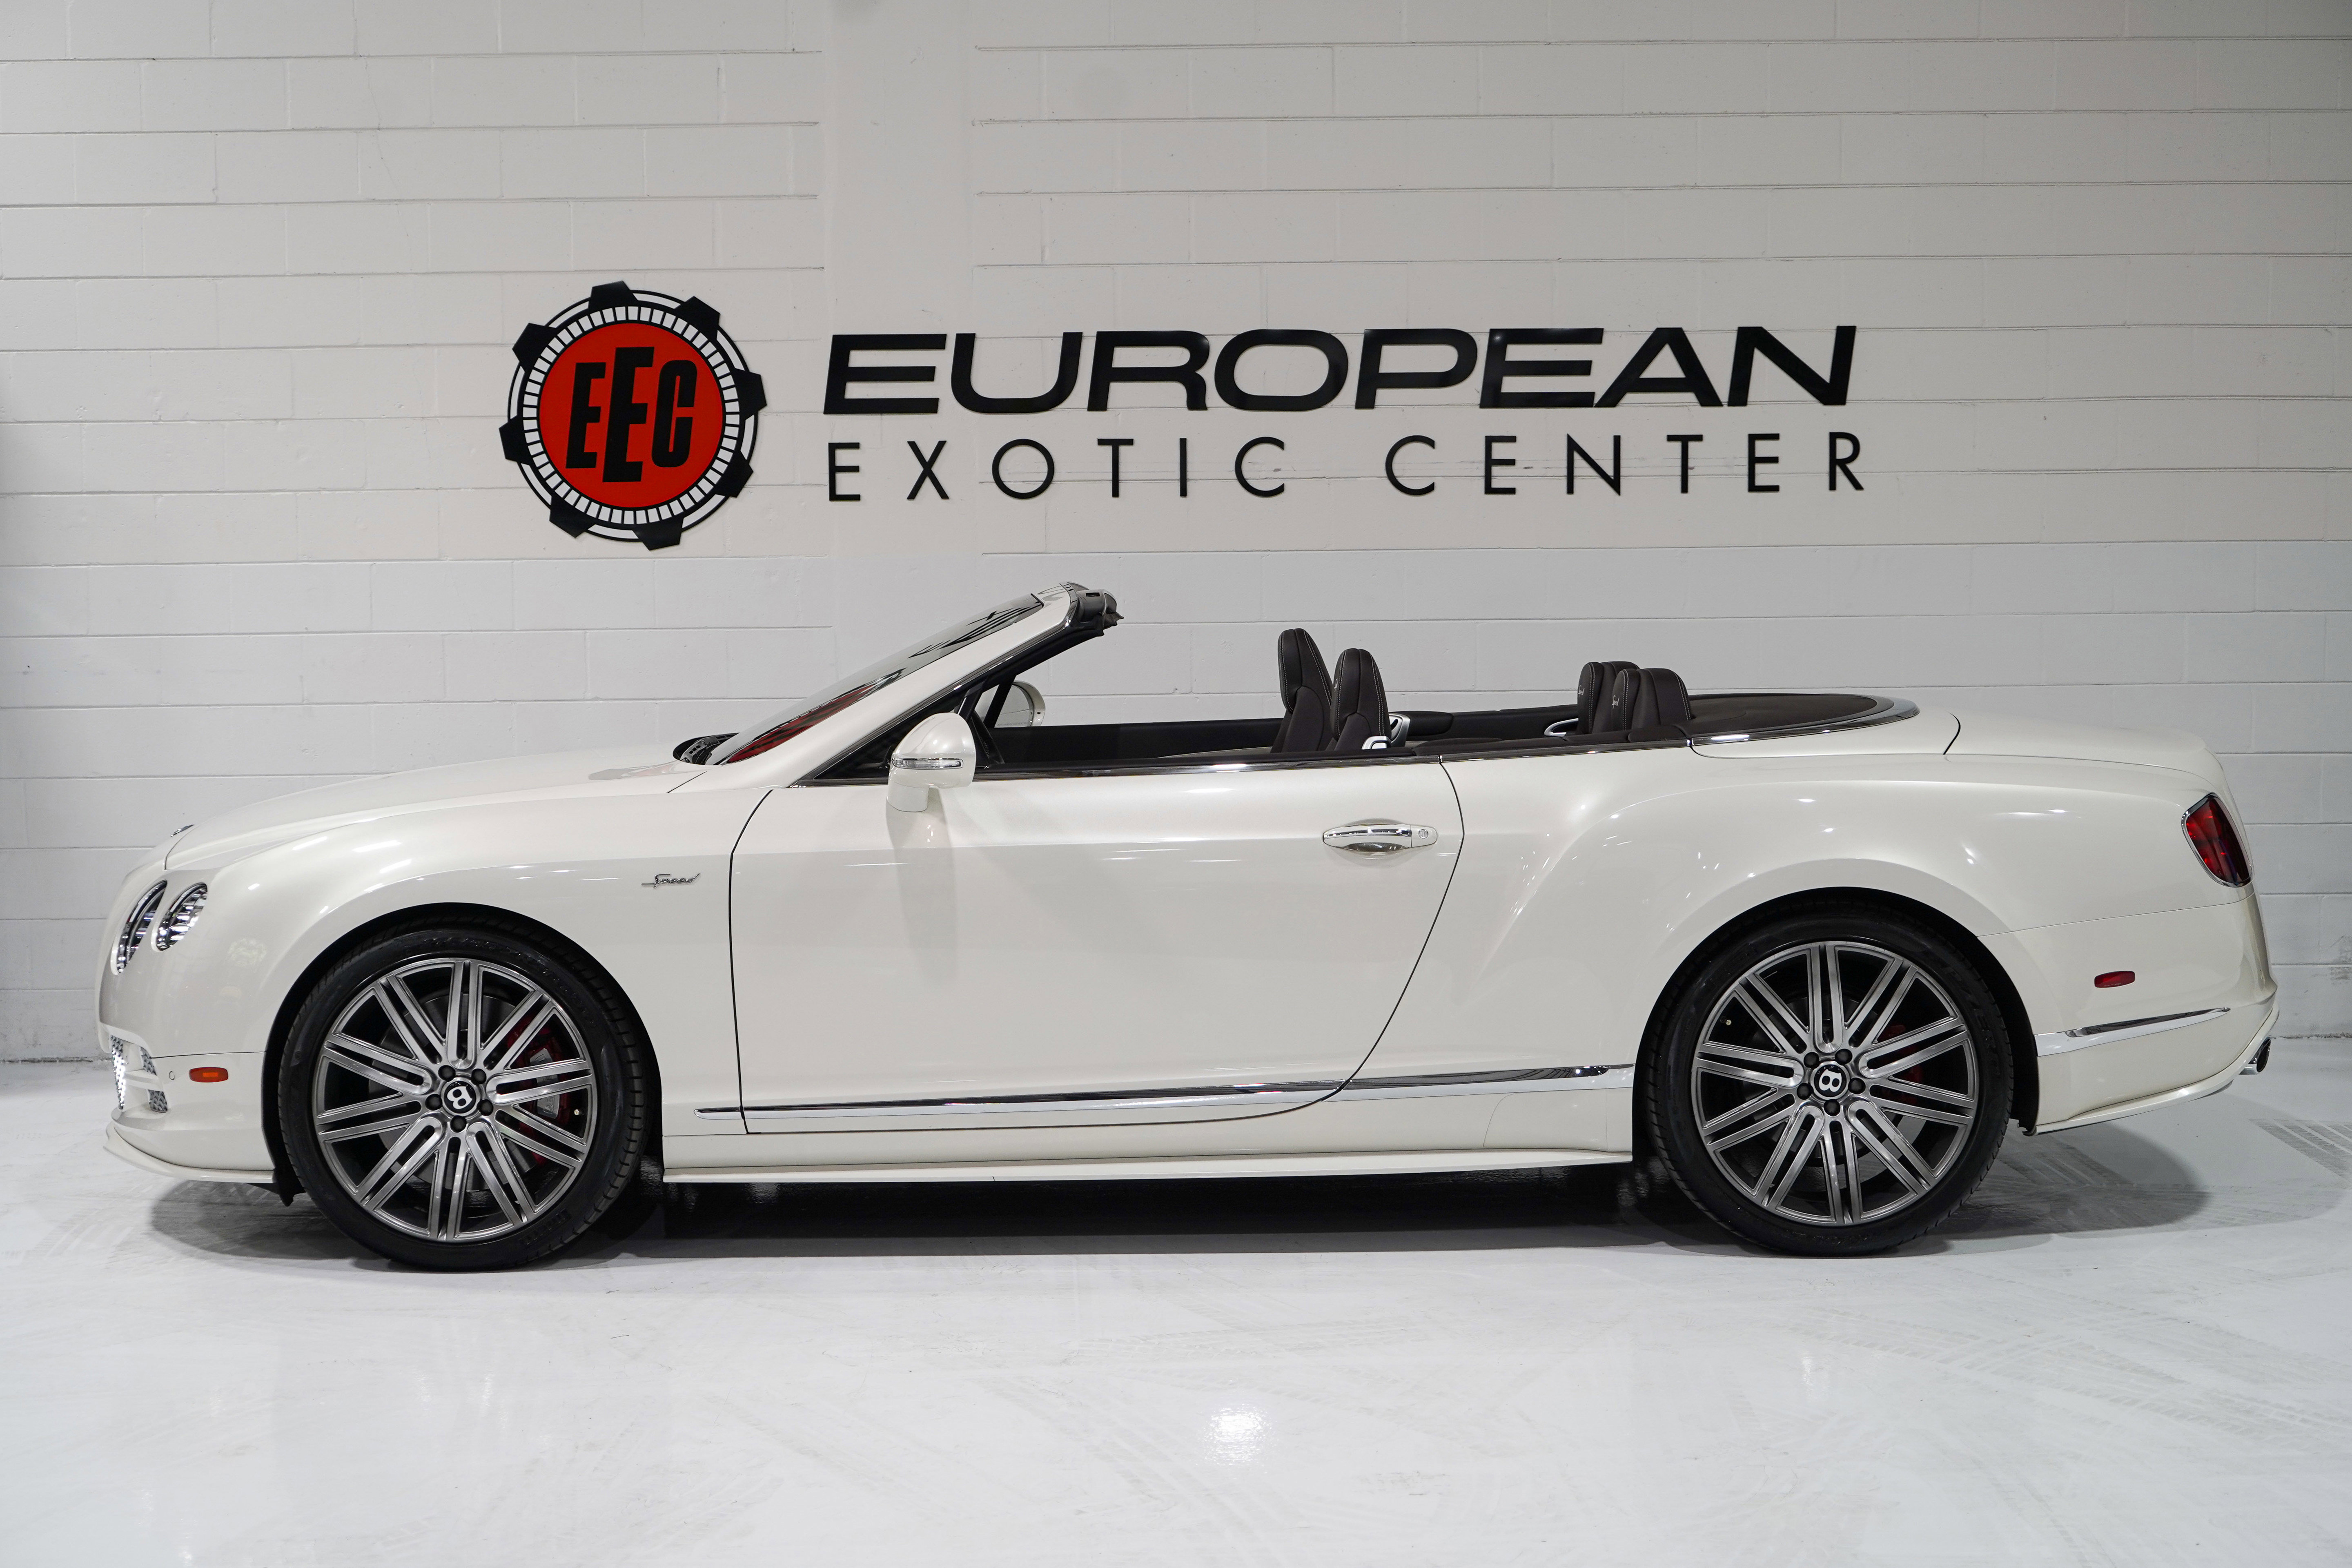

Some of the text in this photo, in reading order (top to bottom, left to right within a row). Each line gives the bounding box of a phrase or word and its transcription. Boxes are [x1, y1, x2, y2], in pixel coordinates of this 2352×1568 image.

[823, 325, 1857, 416] EUROPEAN
[566, 346, 697, 483] EEC
[828, 432, 1864, 501] EXOTIC CENTER
[641, 873, 701, 889] Speed
[447, 1086, 473, 1109] B
[1819, 1069, 1842, 1092] B
